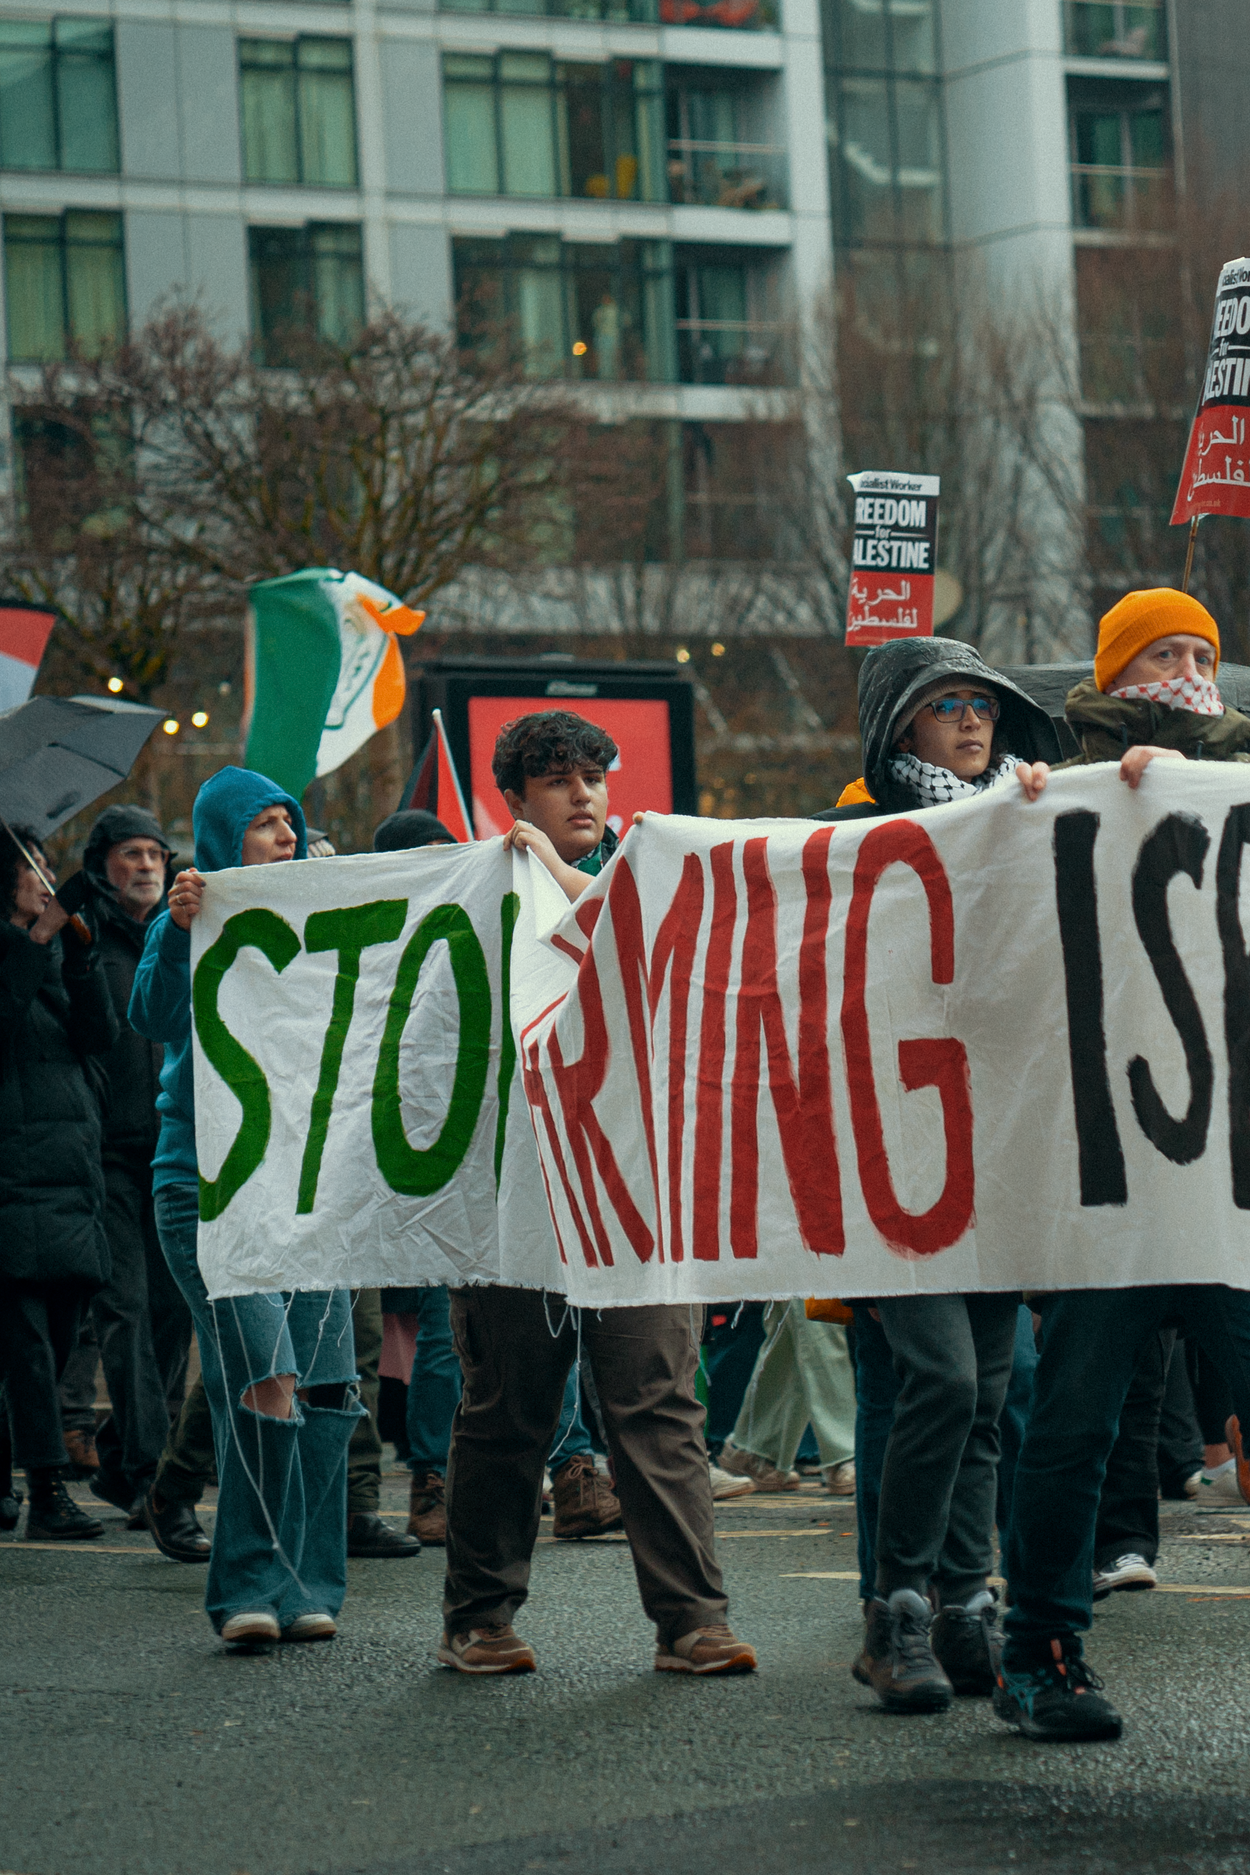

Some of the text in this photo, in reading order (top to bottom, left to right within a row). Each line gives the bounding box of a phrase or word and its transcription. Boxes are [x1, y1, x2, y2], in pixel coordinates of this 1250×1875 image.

[856, 497, 927, 528] REEDOM
[875, 525, 892, 539] for
[853, 538, 930, 569] LESTINE
[194, 891, 521, 1222] STO
